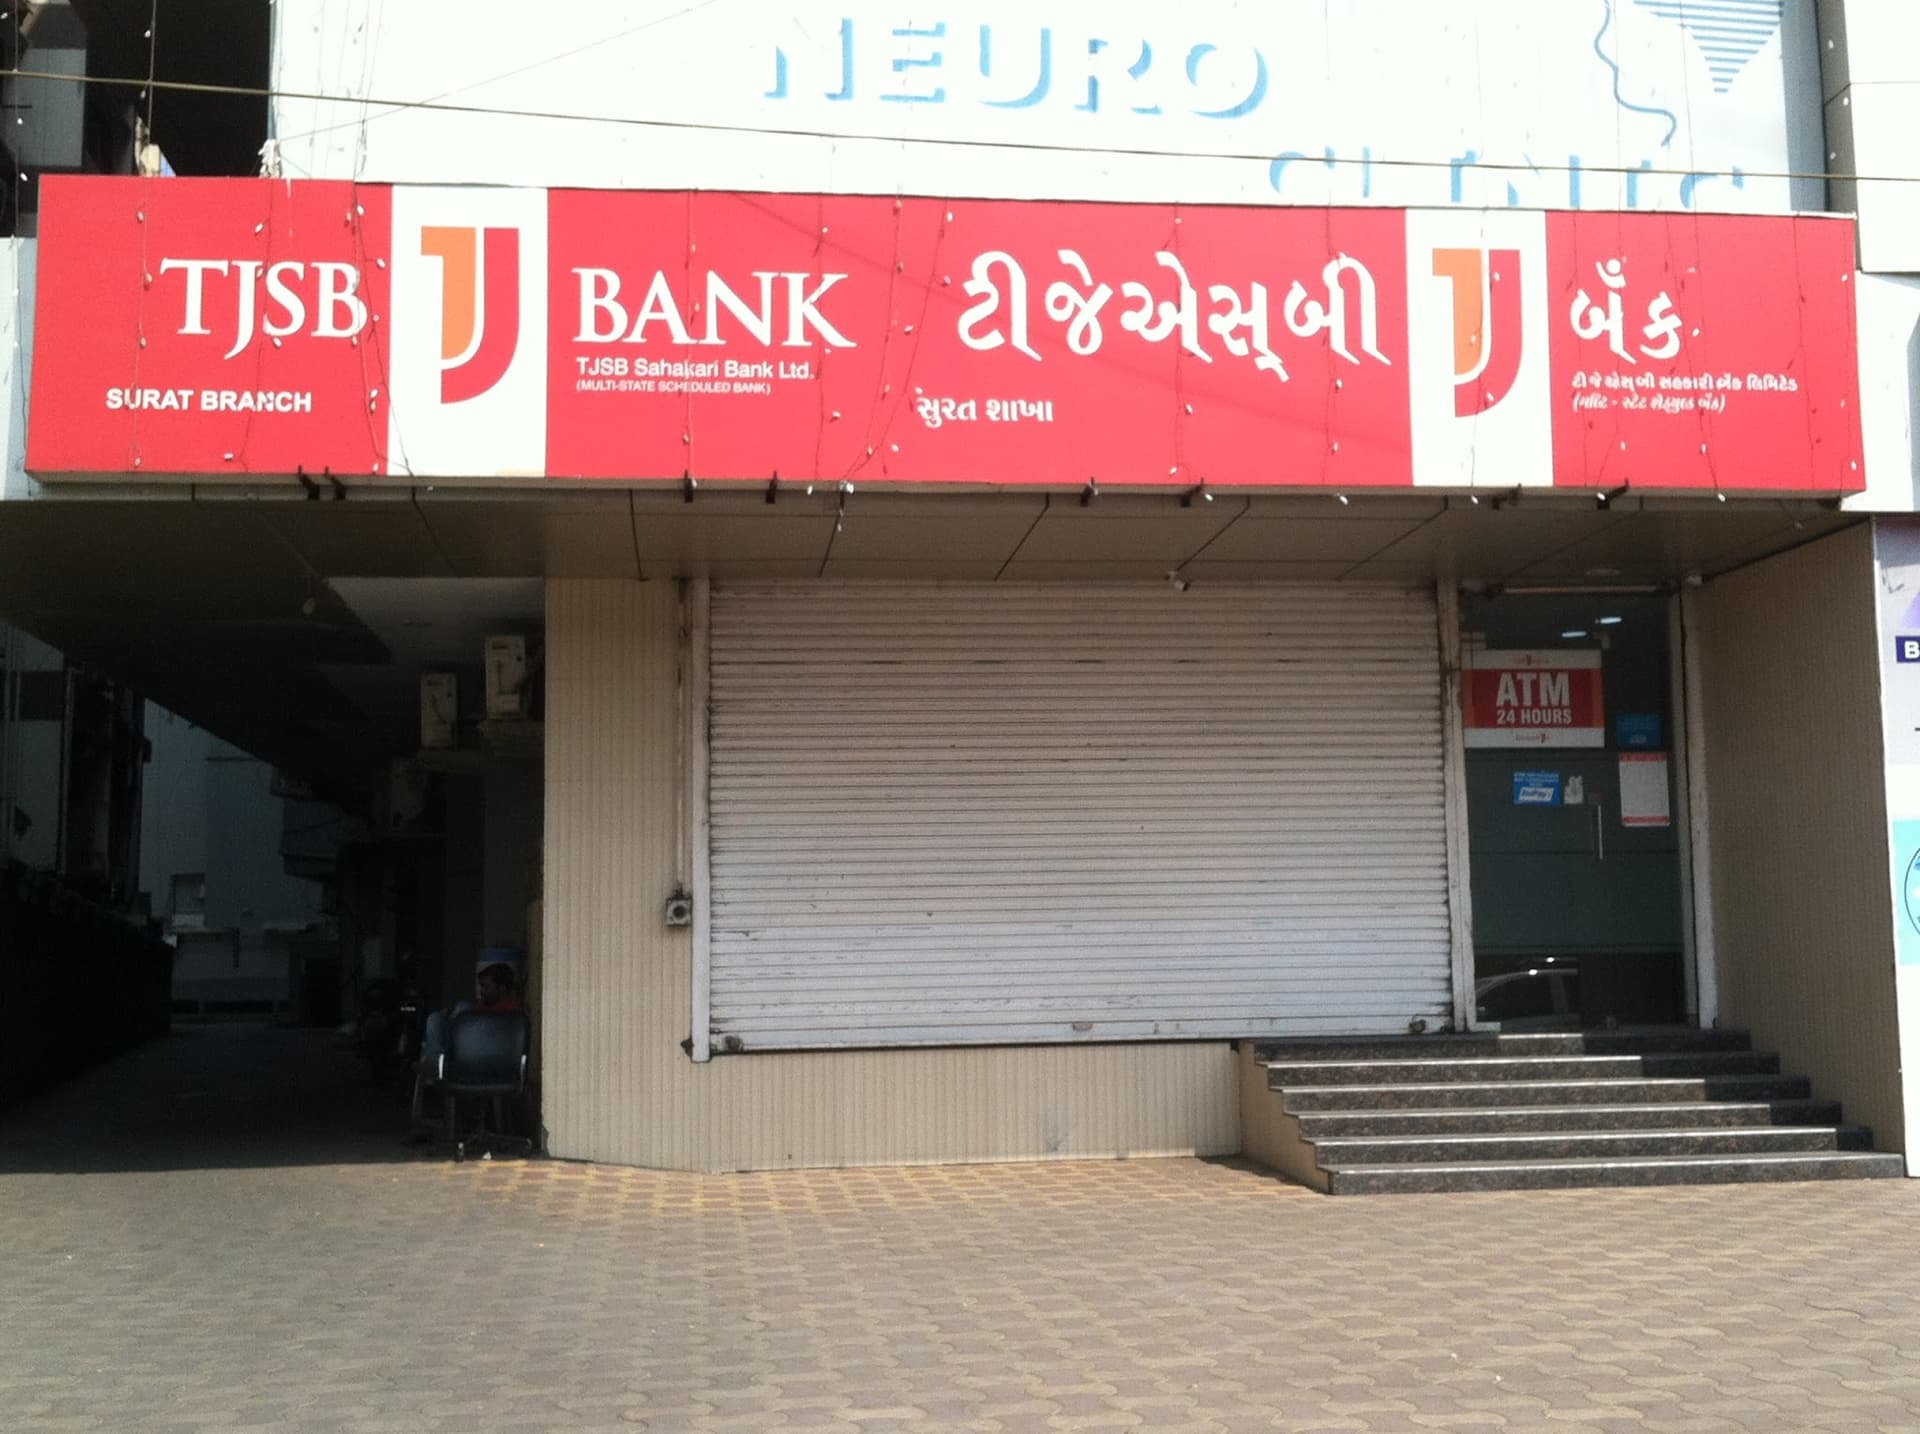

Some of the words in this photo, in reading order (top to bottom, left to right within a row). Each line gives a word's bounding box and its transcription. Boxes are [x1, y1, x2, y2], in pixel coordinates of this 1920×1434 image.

[764, 17, 1268, 119] NEURO
[160, 257, 369, 360] TJSB
[572, 267, 856, 349] BANK
[576, 356, 629, 376] TJSB
[634, 358, 718, 379] Sahakari
[725, 360, 773, 378] Bank
[779, 361, 815, 379] Ltd.
[106, 387, 194, 411] SURAT
[201, 389, 312, 412] BRANCH
[658, 381, 730, 394] SCHEDULED
[734, 382, 771, 395] BANK)
[915, 395, 977, 428] સુરત
[986, 396, 1054, 422] શાખા
[1495, 671, 1570, 708] ATM
[1497, 709, 1516, 725] 24
[1521, 709, 1572, 725] HOURS
